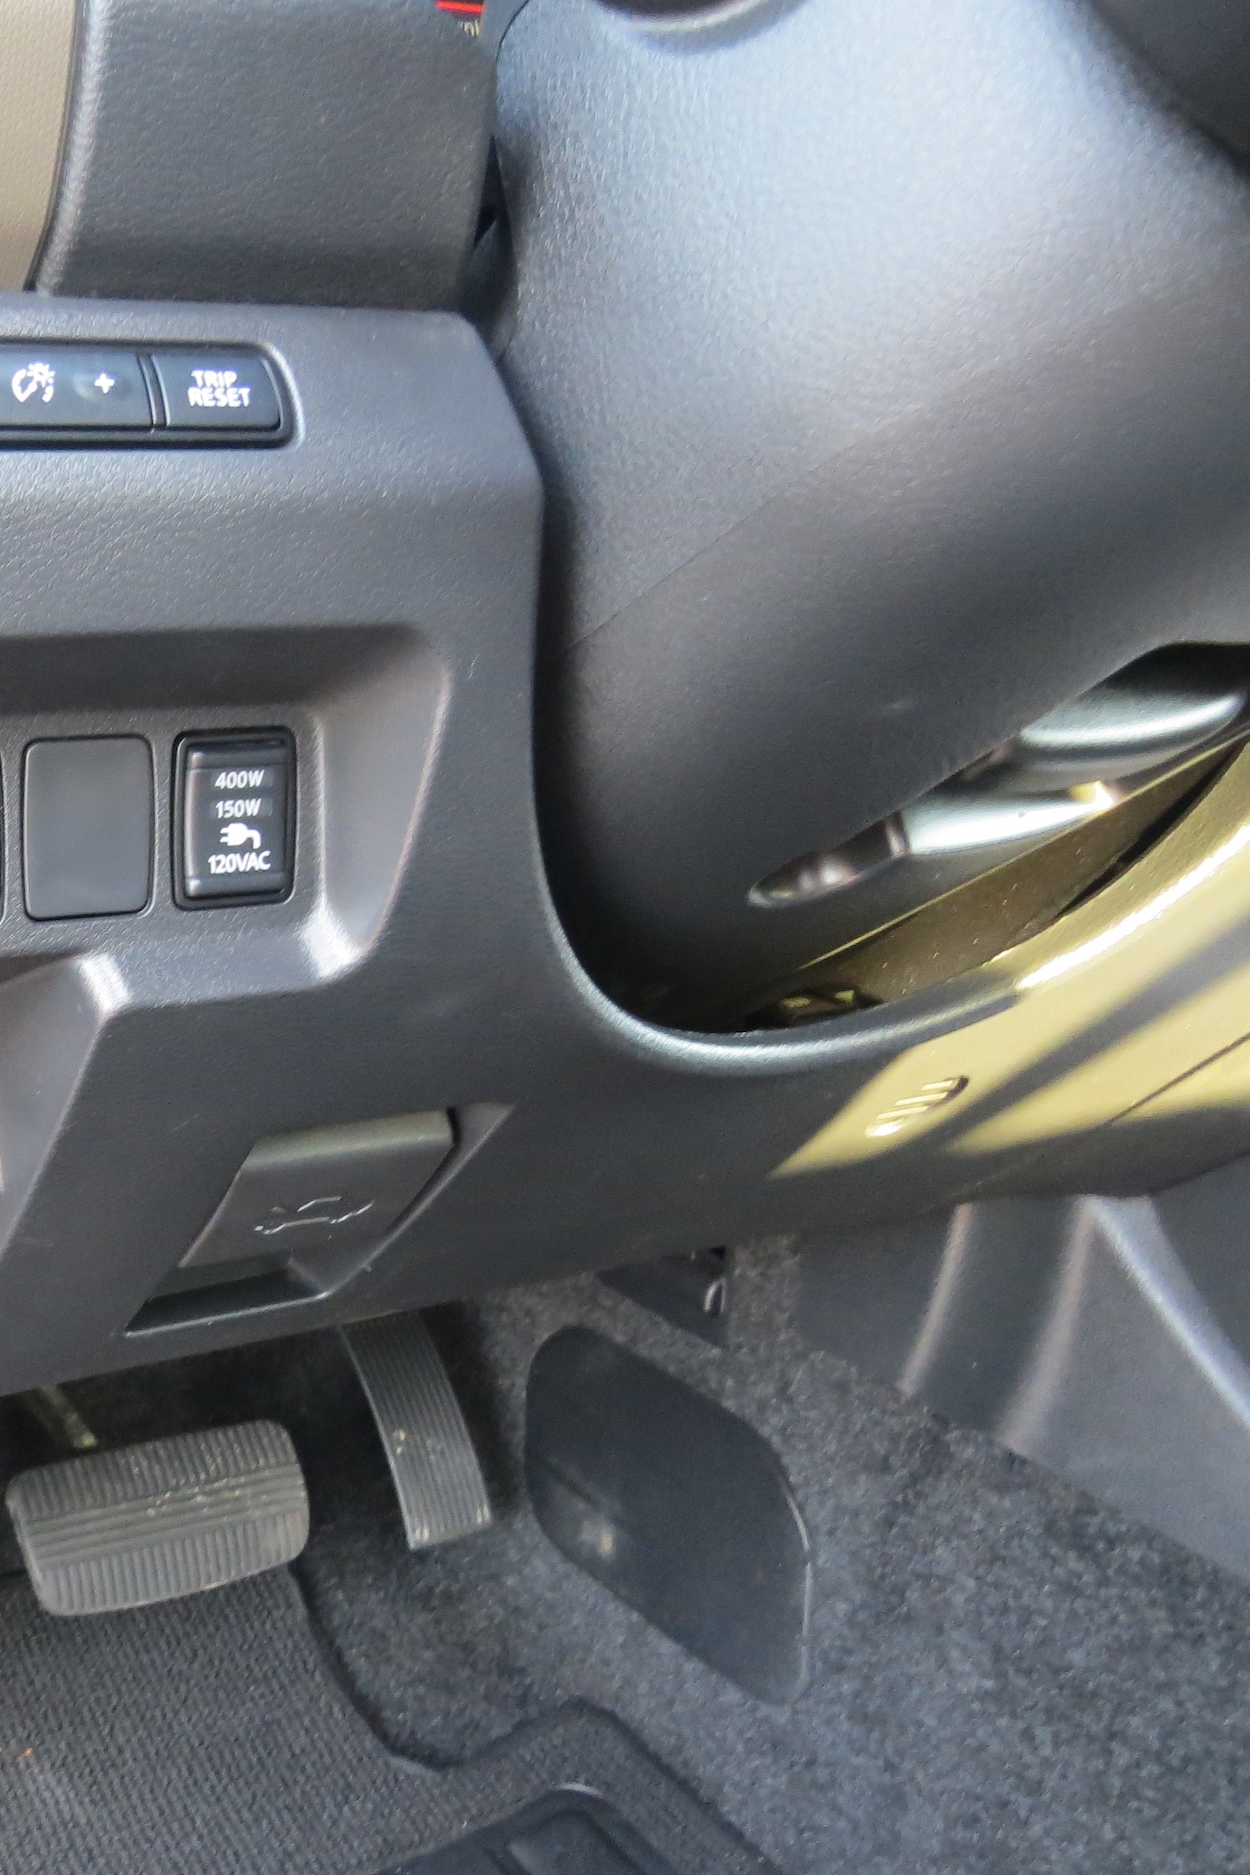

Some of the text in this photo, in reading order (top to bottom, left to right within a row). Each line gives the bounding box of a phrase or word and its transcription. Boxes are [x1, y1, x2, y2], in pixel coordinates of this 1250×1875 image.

[191, 370, 237, 388] TRIP
[187, 387, 251, 408] RESET
[214, 769, 265, 790] 400W
[215, 798, 262, 819] 150W
[207, 850, 271, 874] 120VAC
